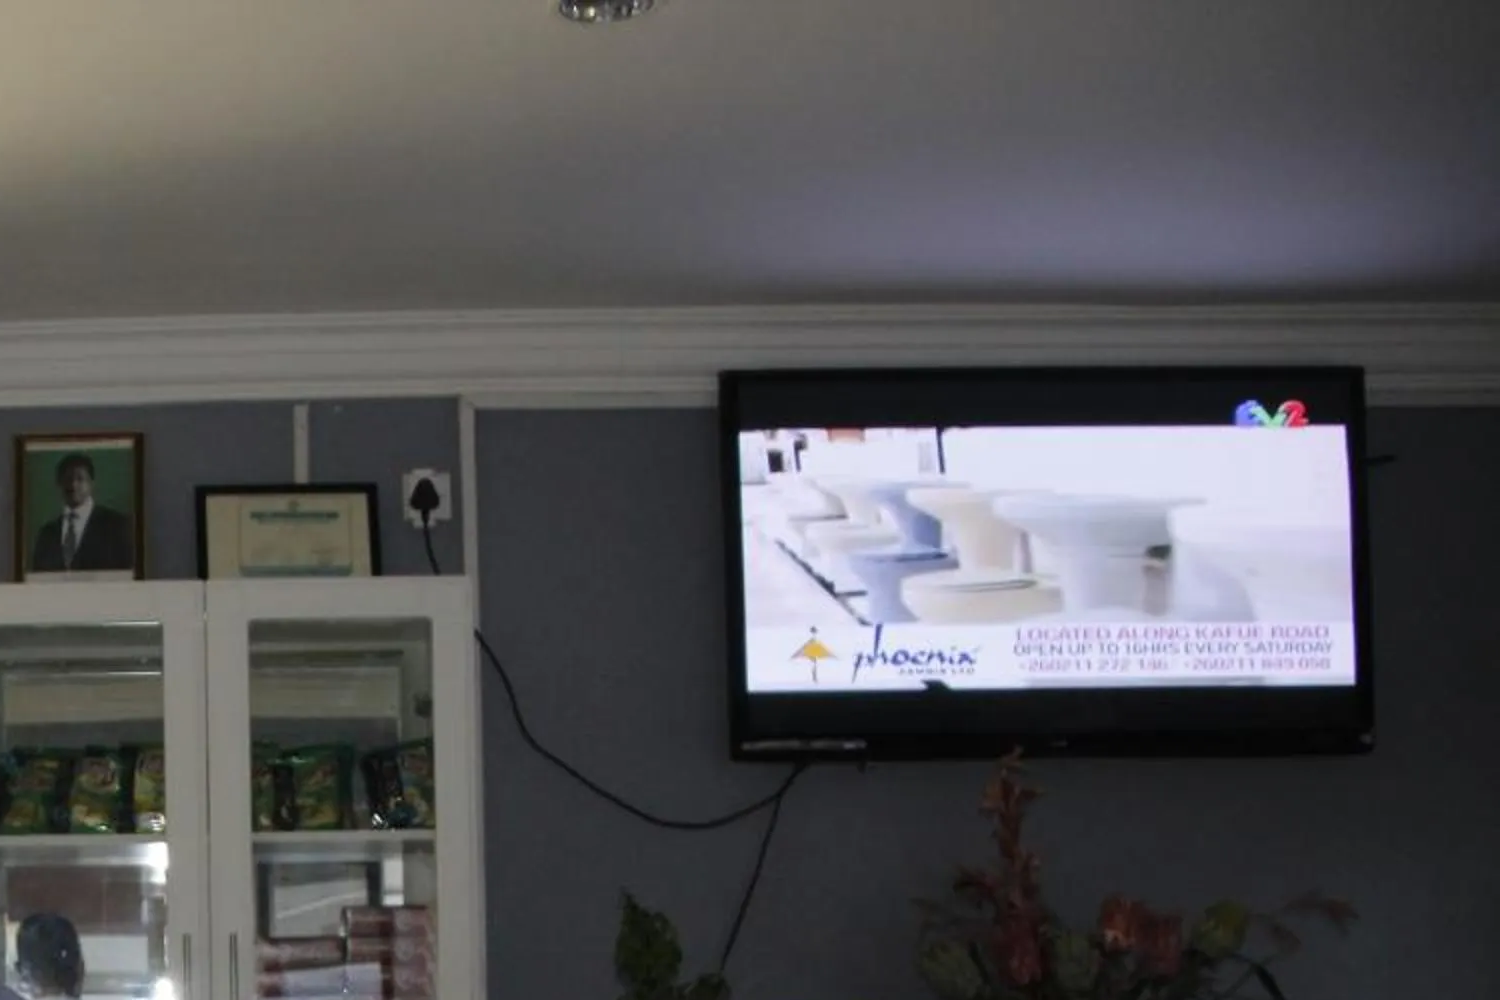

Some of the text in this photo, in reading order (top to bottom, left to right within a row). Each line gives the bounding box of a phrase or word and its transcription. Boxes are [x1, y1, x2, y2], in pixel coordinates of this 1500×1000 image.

[1015, 627, 1112, 641] LOCATED
[1117, 626, 1190, 640] ALONG
[1270, 624, 1331, 639] ROAD
[1013, 642, 1063, 657] OPEN
[1067, 642, 1094, 656] UP
[1098, 642, 1121, 656] TO
[1183, 641, 1238, 655] EVERY
[1244, 640, 1333, 654] SATURDAY
